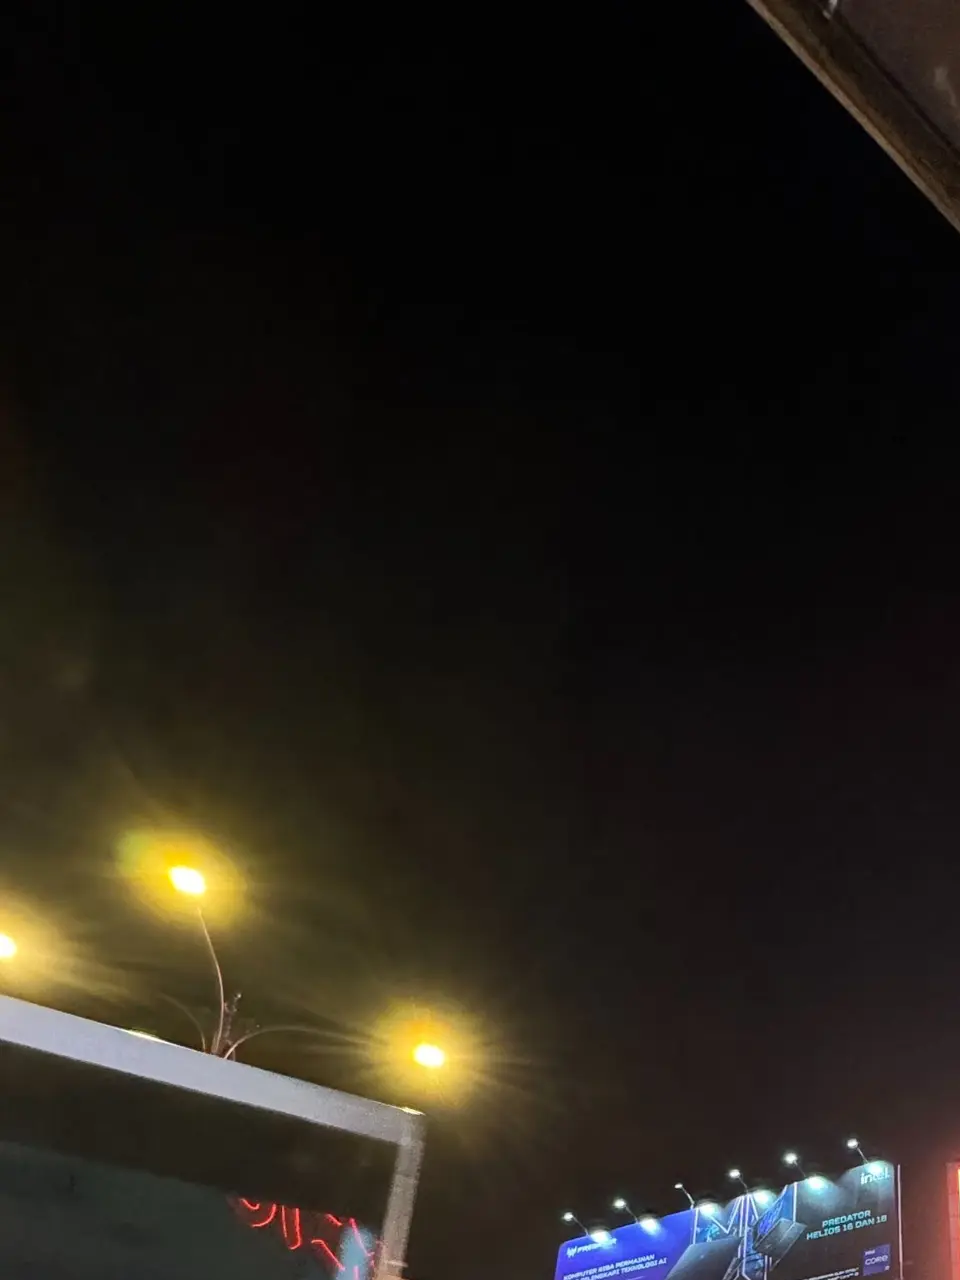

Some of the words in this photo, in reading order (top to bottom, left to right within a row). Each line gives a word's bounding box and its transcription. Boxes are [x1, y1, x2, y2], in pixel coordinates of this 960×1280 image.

[822, 1210, 871, 1227] PREDATOR
[806, 1225, 841, 1240] HELIOS
[855, 1218, 875, 1228] DAN
